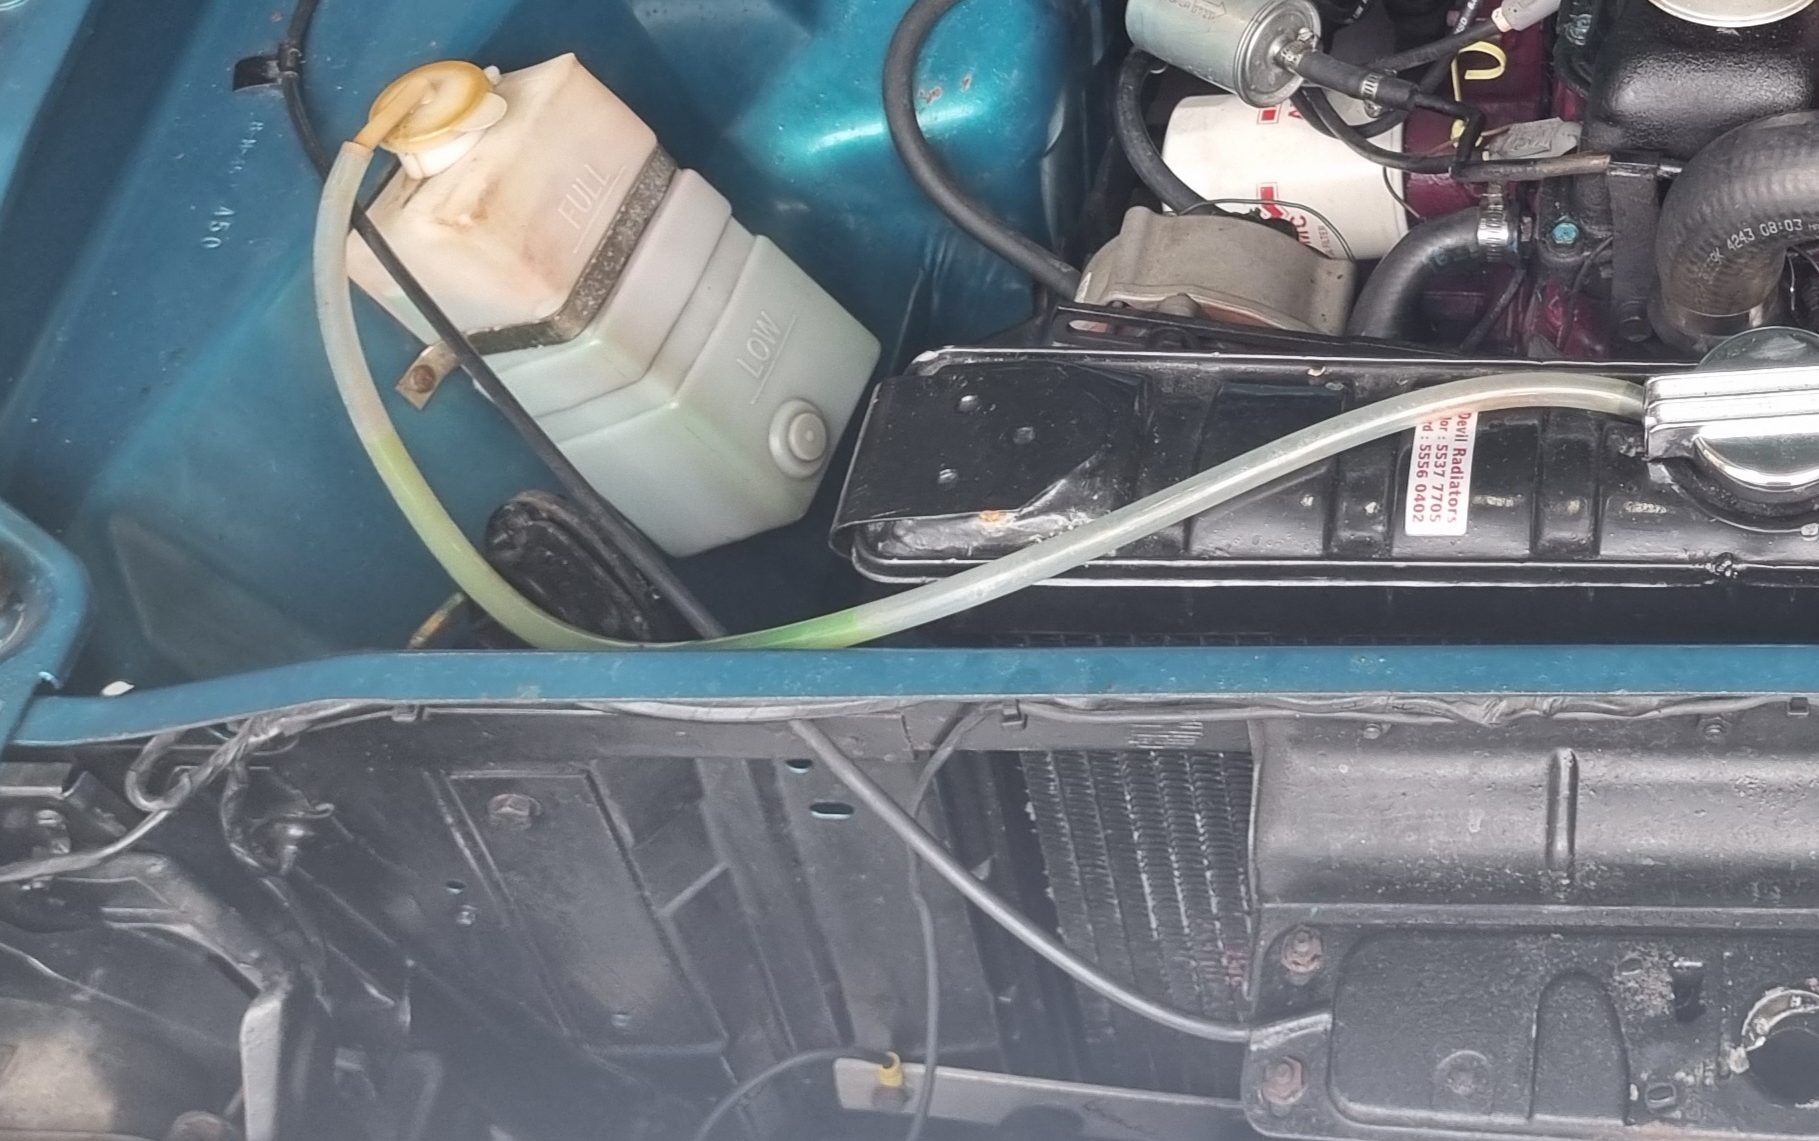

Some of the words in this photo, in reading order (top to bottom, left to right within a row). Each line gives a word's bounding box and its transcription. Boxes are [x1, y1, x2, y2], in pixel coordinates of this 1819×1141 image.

[558, 163, 611, 230] FULL
[1726, 227, 1756, 252] 4243
[1758, 218, 1803, 238] 08:03
[736, 309, 781, 380] LOW
[1454, 412, 1472, 442] Devil
[1416, 444, 1432, 479] 5556
[1433, 444, 1449, 478] 5537
[1412, 483, 1427, 523] 0402
[1429, 483, 1445, 523] 7705
[1447, 447, 1467, 524] Radiators
